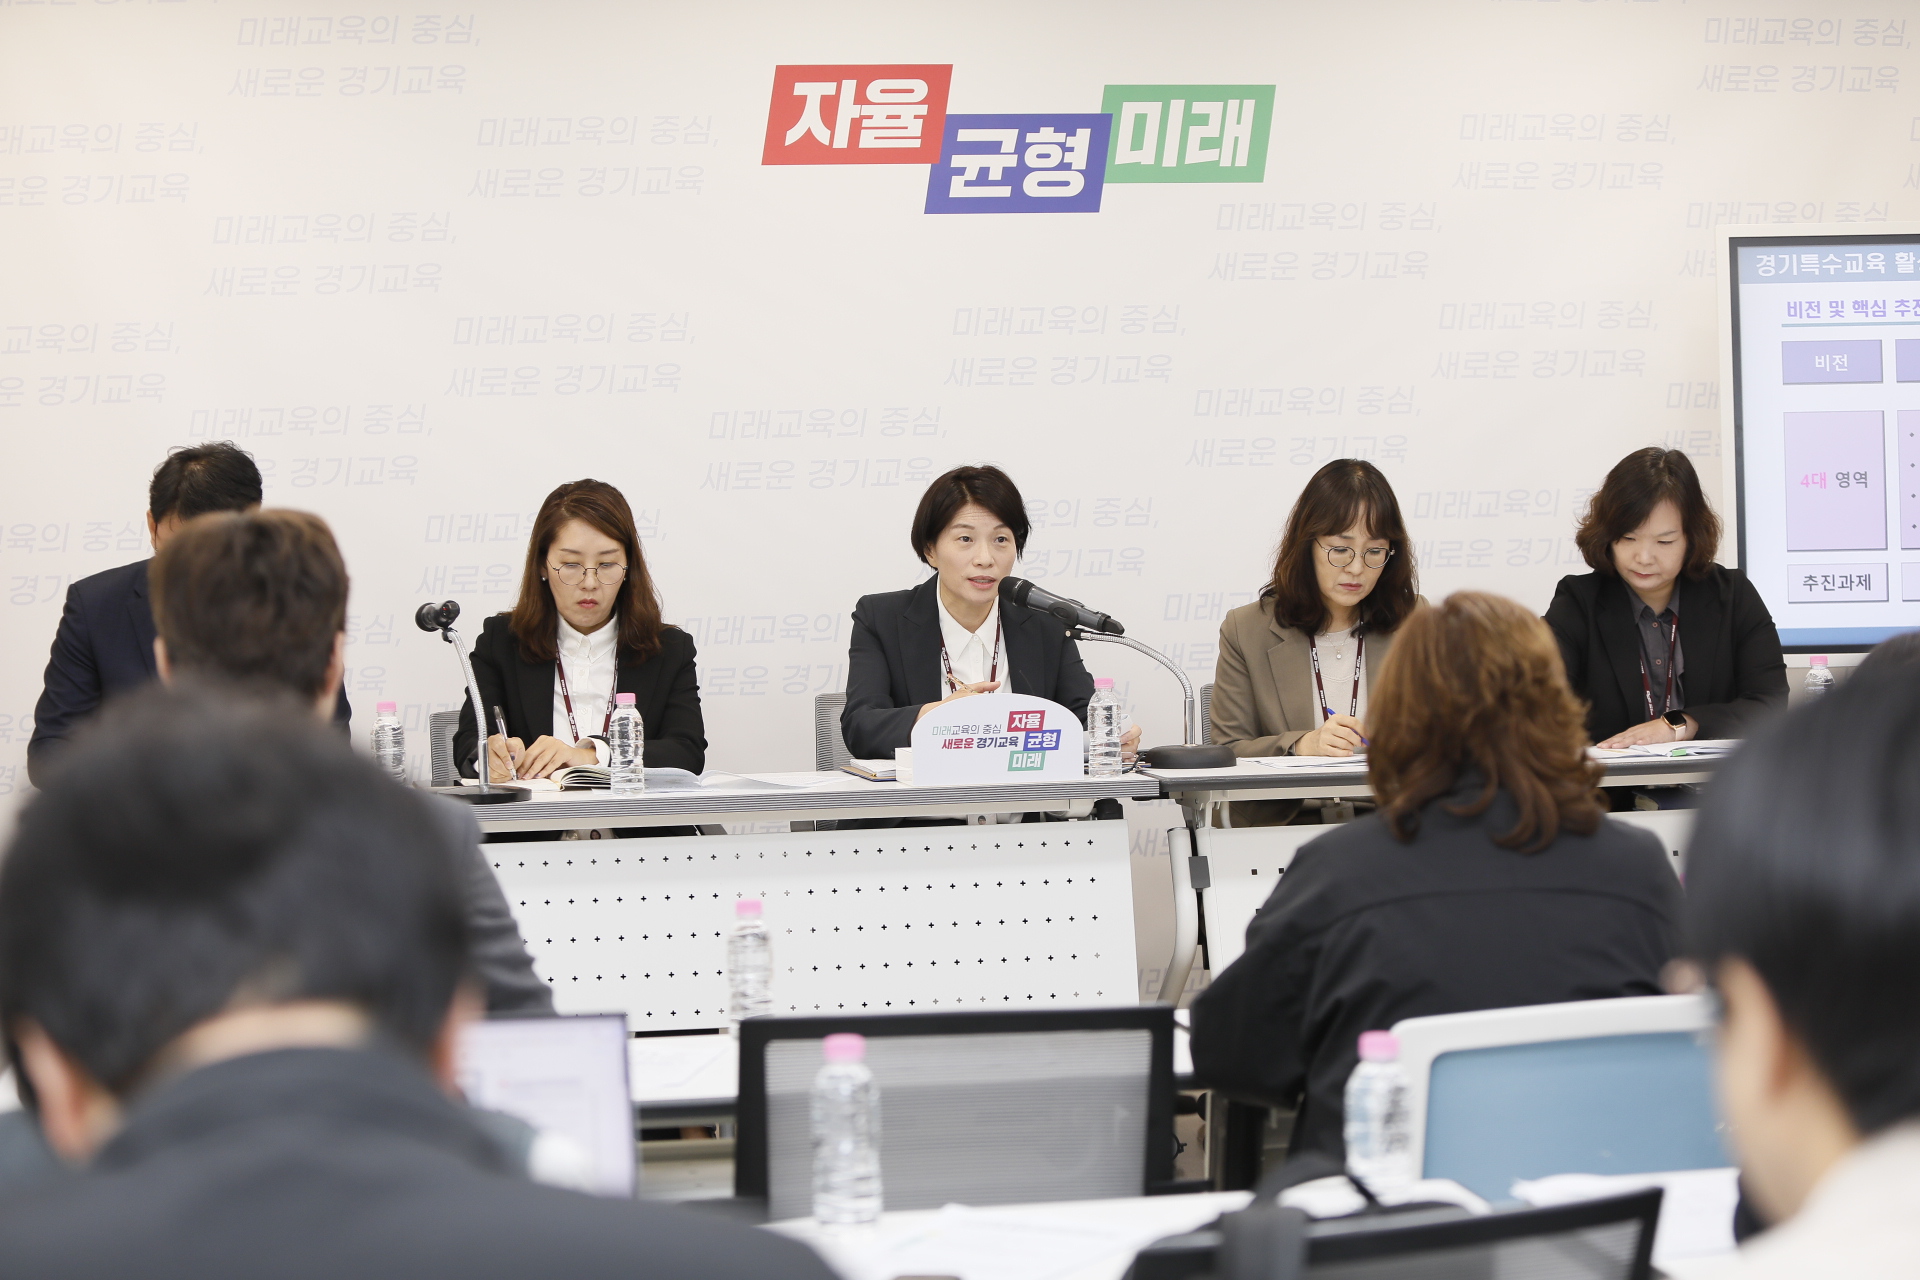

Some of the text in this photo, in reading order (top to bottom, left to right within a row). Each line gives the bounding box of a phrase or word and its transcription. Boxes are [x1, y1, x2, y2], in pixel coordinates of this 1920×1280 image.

[237, 14, 480, 47] 미래교육의 중심,
[1705, 17, 1911, 49] 미래교육의 중심,
[228, 65, 466, 97] 새로운 경기교육
[1696, 65, 1899, 94] 새로운 경기교육
[785, 79, 928, 148] 자율
[135, 122, 203, 154] 중심,
[477, 116, 718, 147] 미래교육의 중심,
[1115, 99, 1256, 167] 미래
[1460, 114, 1675, 145] 미래교육의 중심,
[949, 127, 1091, 198] 균형
[1452, 162, 1663, 190] 새로운 경기교육
[62, 173, 189, 205] 경기교육
[468, 166, 704, 198] 새로운 경기교육
[213, 212, 456, 245] 미래교육의 중심,
[1216, 202, 1442, 233] 미래교육의 중심,
[1208, 251, 1428, 281] 새로운 경기교육
[1756, 252, 1920, 276] 경기특수교육 활
[204, 263, 442, 297] 새로운 경기교육
[953, 305, 1185, 336] 미래교육의 중심,
[1439, 300, 1658, 331] 미래교육의 중심,
[1787, 300, 1821, 319] 비전
[1829, 300, 1845, 318] 및
[1852, 299, 1887, 318] 핵심
[112, 322, 180, 354] 중심,
[453, 312, 695, 346] 미래교육의 중심,
[944, 354, 1172, 387] 새로운 경기교육
[1431, 349, 1645, 379] 새로운 경기교육
[1815, 354, 1848, 372] 비전
[39, 374, 165, 406] 경기교육
[444, 363, 681, 397] 새로운 경기교육
[1194, 386, 1420, 417] 미래교육의 중심,
[188, 404, 432, 439] 미래교육의 중심,
[709, 407, 947, 440] 미래교육의 중심,
[1185, 437, 1276, 467] 새로운
[291, 455, 418, 487] 경기교육
[700, 456, 934, 491] 새로운 경기교육
[1800, 471, 1869, 490] 4대 영역
[1414, 489, 1560, 519] 미래교육의
[415, 564, 512, 597] 새로운
[1803, 573, 1872, 592] 추진과제
[932, 724, 1002, 736] 미래교육의 중심
[1011, 713, 1041, 729] 자율
[942, 736, 1019, 749] 새로운 경기교육
[1027, 732, 1058, 748] 균형
[1012, 752, 1042, 768] 미래
